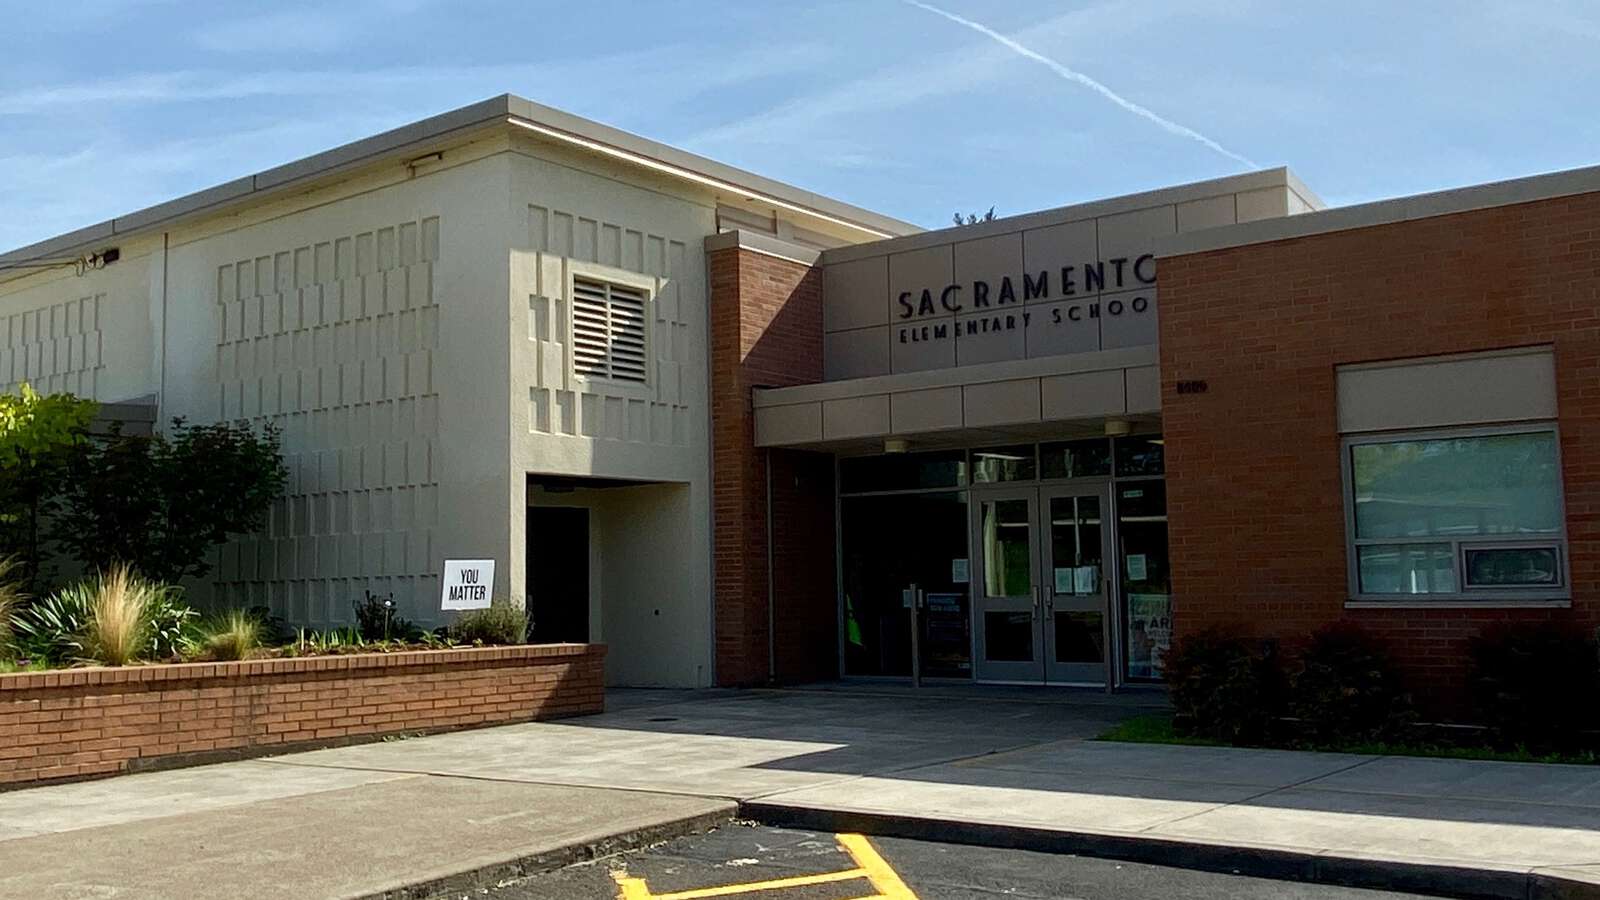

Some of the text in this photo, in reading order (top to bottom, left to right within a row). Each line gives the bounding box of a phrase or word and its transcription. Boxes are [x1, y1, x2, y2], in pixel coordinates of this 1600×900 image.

[898, 253, 1157, 319] SACRAMENTO
[900, 297, 1148, 345] ELEMENTARY SCHOO
[461, 569, 479, 584] YOU
[449, 585, 486, 601] MATTER
[1149, 615, 1171, 629] AR
